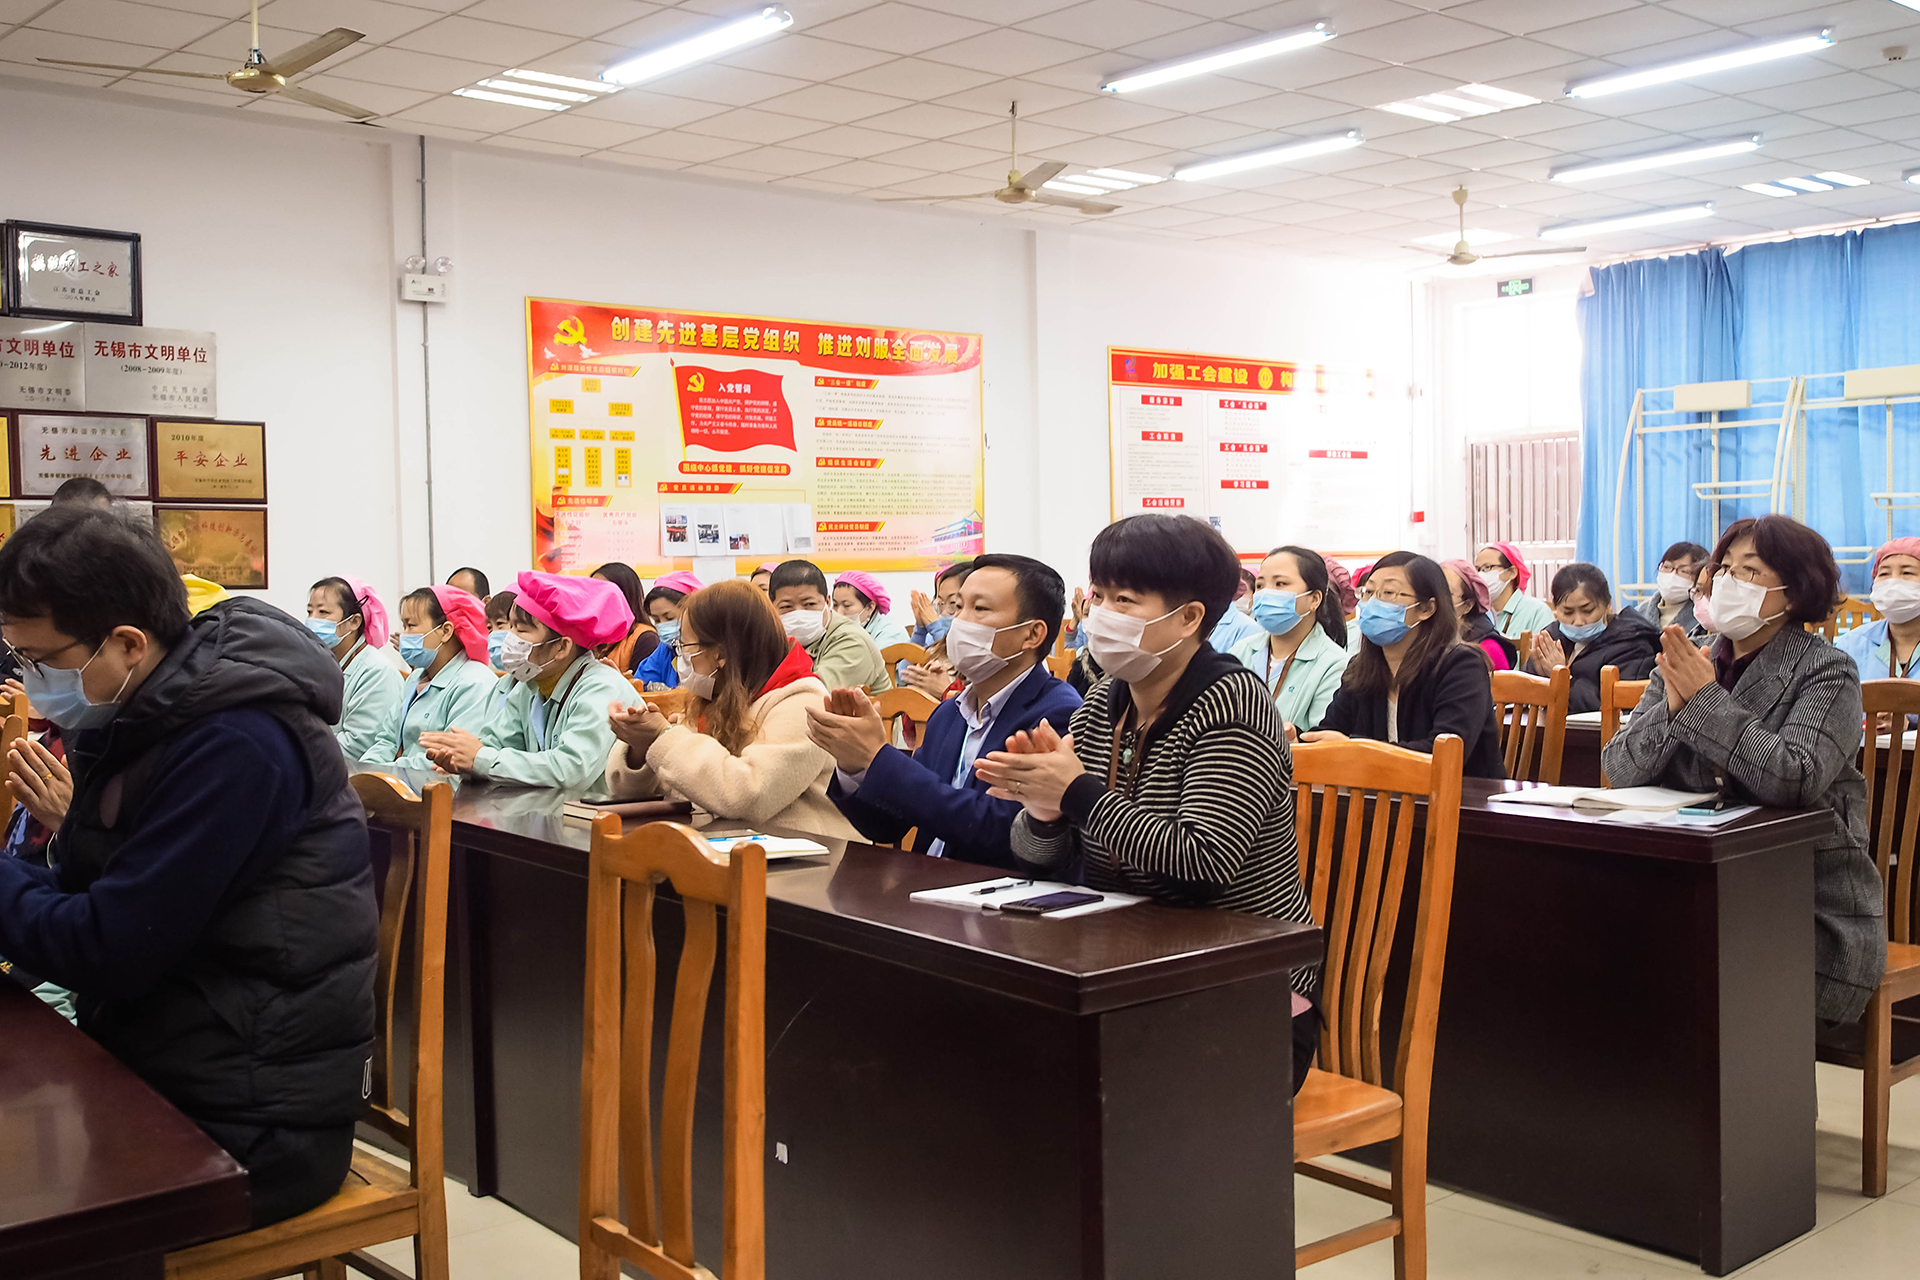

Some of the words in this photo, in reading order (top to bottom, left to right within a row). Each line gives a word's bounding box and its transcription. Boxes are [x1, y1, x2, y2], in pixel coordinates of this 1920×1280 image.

[611, 316, 800, 354] 创建先进基层党组织
[817, 332, 959, 365] 推进刘服全面发展
[94, 340, 208, 363] 无锡市文明单位
[1152, 362, 1249, 385] 加强工会建设
[718, 382, 752, 394] 入党誓词
[40, 444, 132, 462] 先进企业
[173, 450, 248, 468] 平安企业
